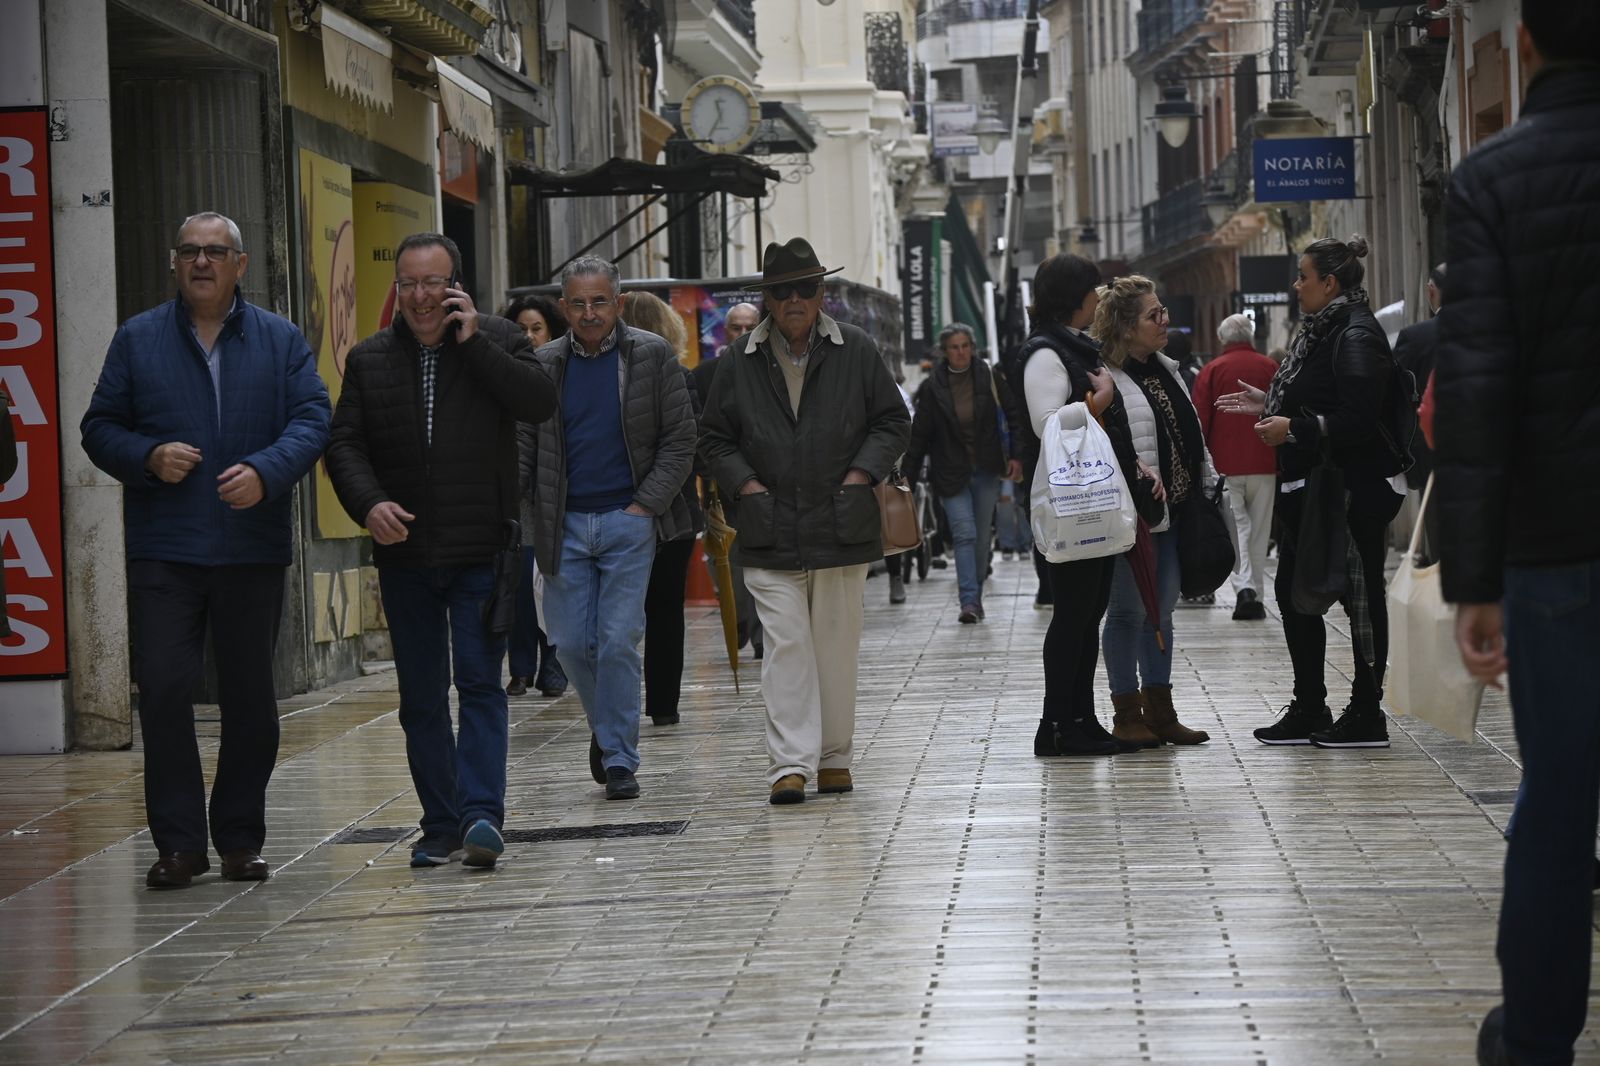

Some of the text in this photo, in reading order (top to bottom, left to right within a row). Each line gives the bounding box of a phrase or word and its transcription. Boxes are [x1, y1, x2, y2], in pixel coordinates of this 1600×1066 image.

[1264, 152, 1346, 172] NOTARÍA
[1313, 177, 1345, 187] NUEVO
[909, 245, 925, 341] BIMBA Y LOLA
